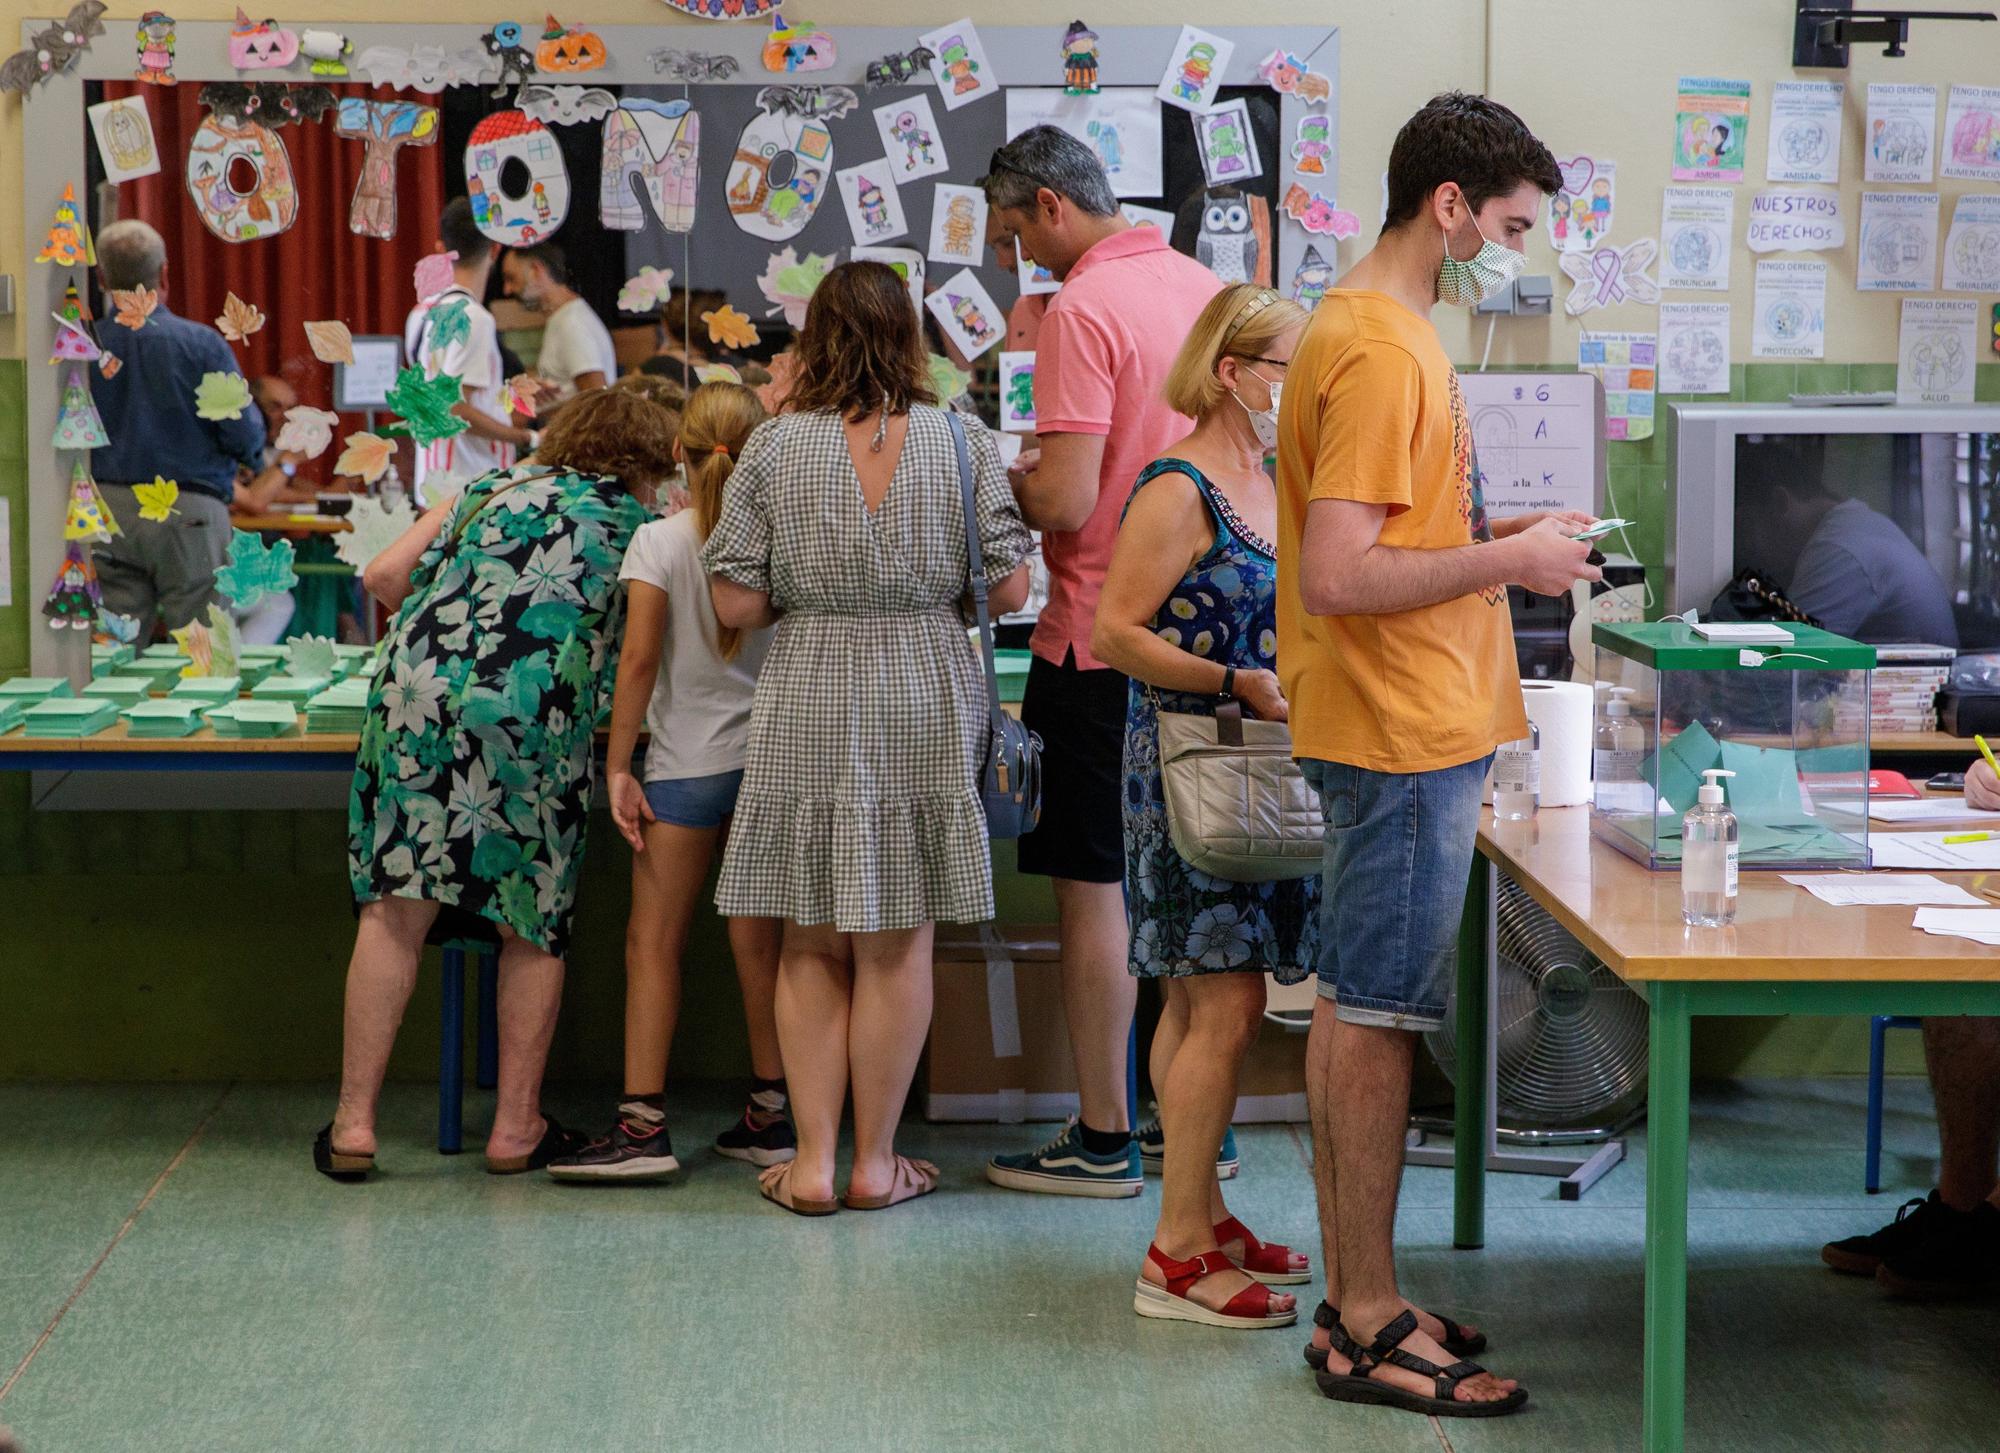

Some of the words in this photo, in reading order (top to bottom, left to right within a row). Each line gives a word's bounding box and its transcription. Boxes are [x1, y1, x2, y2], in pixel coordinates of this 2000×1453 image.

[1680, 78, 1708, 87] TENGO
[1711, 80, 1750, 89] DERECHO
[1775, 82, 1801, 91] TENGO
[1803, 83, 1843, 92] DERECHO
[1869, 85, 1895, 94] TENGO
[1897, 86, 1935, 95] DERECHO
[1952, 87, 1979, 96] TENGO
[1694, 171, 1720, 179] AMOR
[1783, 171, 1822, 180] AMISTAD
[1666, 189, 1693, 197] TENGO
[1695, 189, 1733, 198] DERECHO
[1864, 194, 1894, 203] TENGO
[1896, 195, 1938, 203] DERECHO
[1751, 195, 1837, 216] NUESTROS
[1750, 224, 1833, 241] DERECHOS
[1758, 262, 1785, 271] TENGO
[1787, 263, 1826, 272] DERECHO
[1669, 279, 1717, 288] DENUNCIAR
[1874, 280, 1917, 288] VIVIENDA
[1662, 305, 1689, 313] TENGO
[1691, 305, 1729, 314] DERECHO
[1904, 301, 1933, 310] TENGO
[1935, 301, 1977, 310] DERECHO
[1762, 346, 1814, 356] PROTECCIÓN
[1535, 383, 1550, 401] 6
[1681, 383, 1707, 391] JUGAR
[1535, 417, 1547, 440] A
[1513, 480, 1519, 488] a
[1521, 478, 1531, 488] la
[1543, 472, 1554, 485] K
[1499, 499, 1526, 509] primer
[1529, 499, 1564, 509] apellido)
